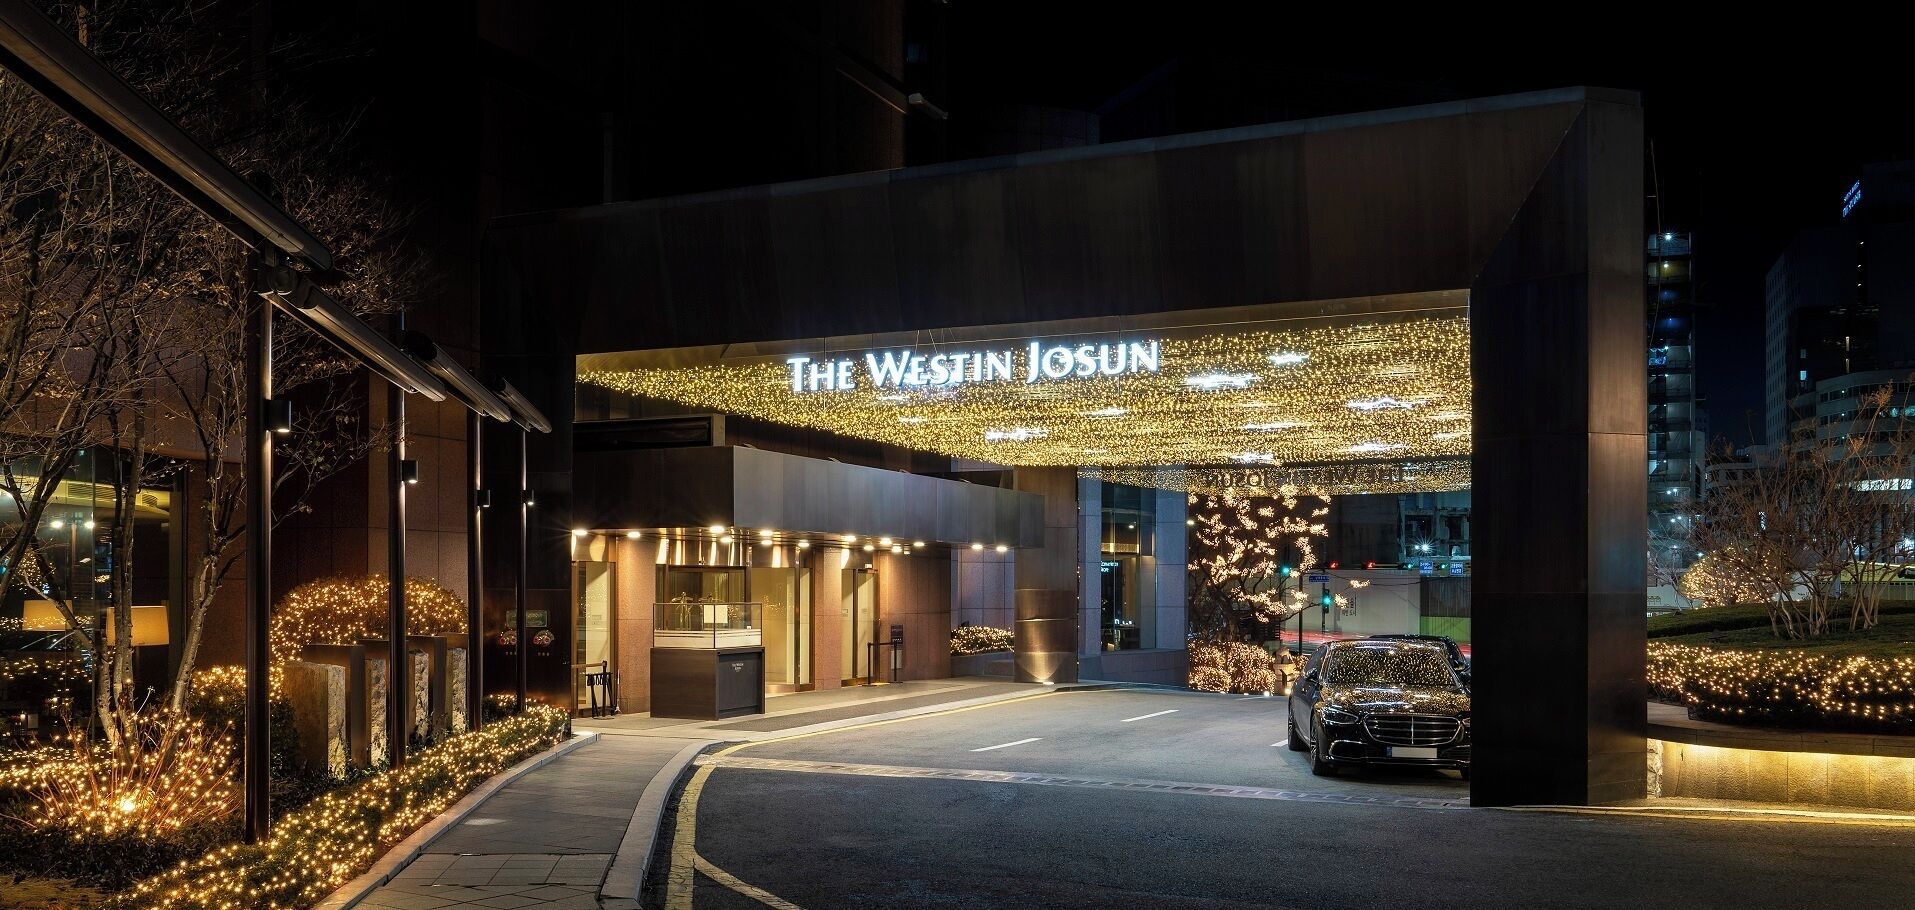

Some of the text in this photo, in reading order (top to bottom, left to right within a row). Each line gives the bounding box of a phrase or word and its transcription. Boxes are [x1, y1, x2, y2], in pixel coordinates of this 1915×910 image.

[787, 341, 1159, 393] THE WESTIN JOSUN
